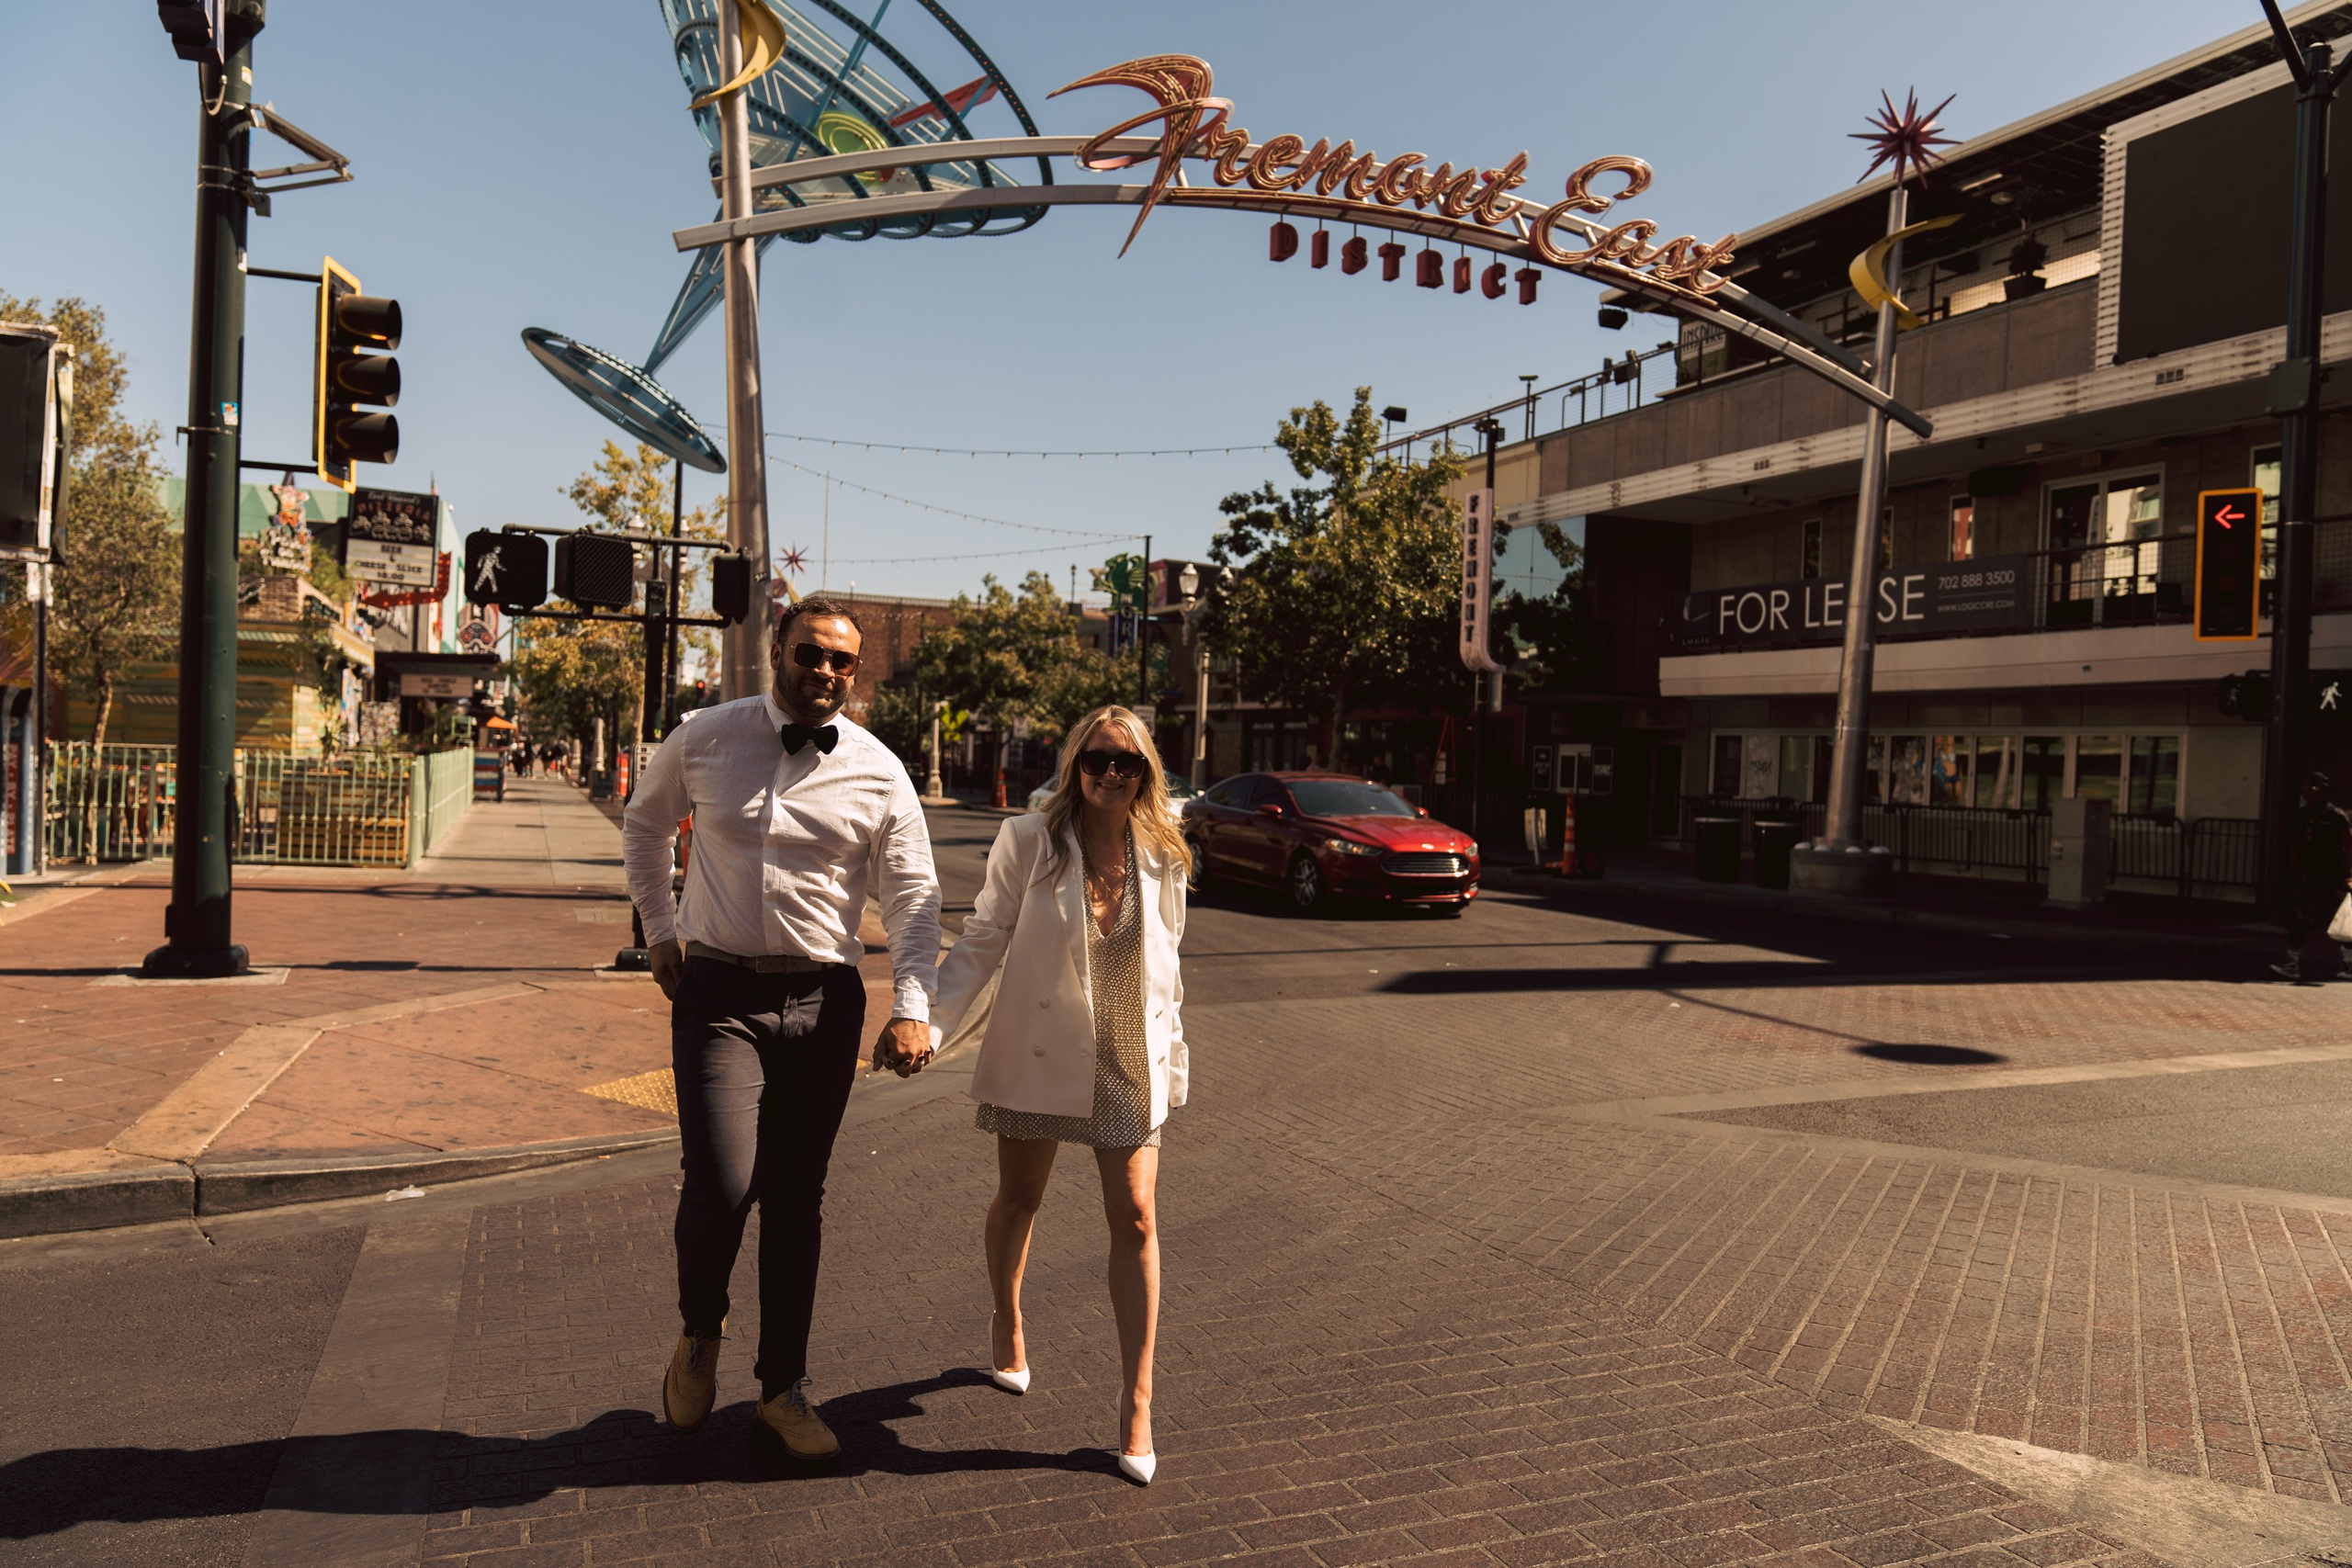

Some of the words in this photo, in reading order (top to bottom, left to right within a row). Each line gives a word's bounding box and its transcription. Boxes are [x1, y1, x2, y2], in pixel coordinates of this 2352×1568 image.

[1046, 53, 1529, 259] Fremont
[1530, 154, 1739, 295] East
[1269, 221, 1543, 306] DISTRICT
[380, 544, 402, 555] BEER
[396, 563, 423, 573] SLICE
[1464, 494, 1480, 642] FREMONT
[1938, 574, 1959, 590] 702
[1961, 572, 1983, 588] 888
[1985, 570, 2016, 586] 3500
[1719, 589, 1790, 636] FOR
[1804, 574, 1925, 629] LESE
[1681, 637, 1711, 646] LOGIC
[7, 742, 19, 768] PAY
[6, 781, 17, 800] BY
[6, 812, 17, 856] PLATE
